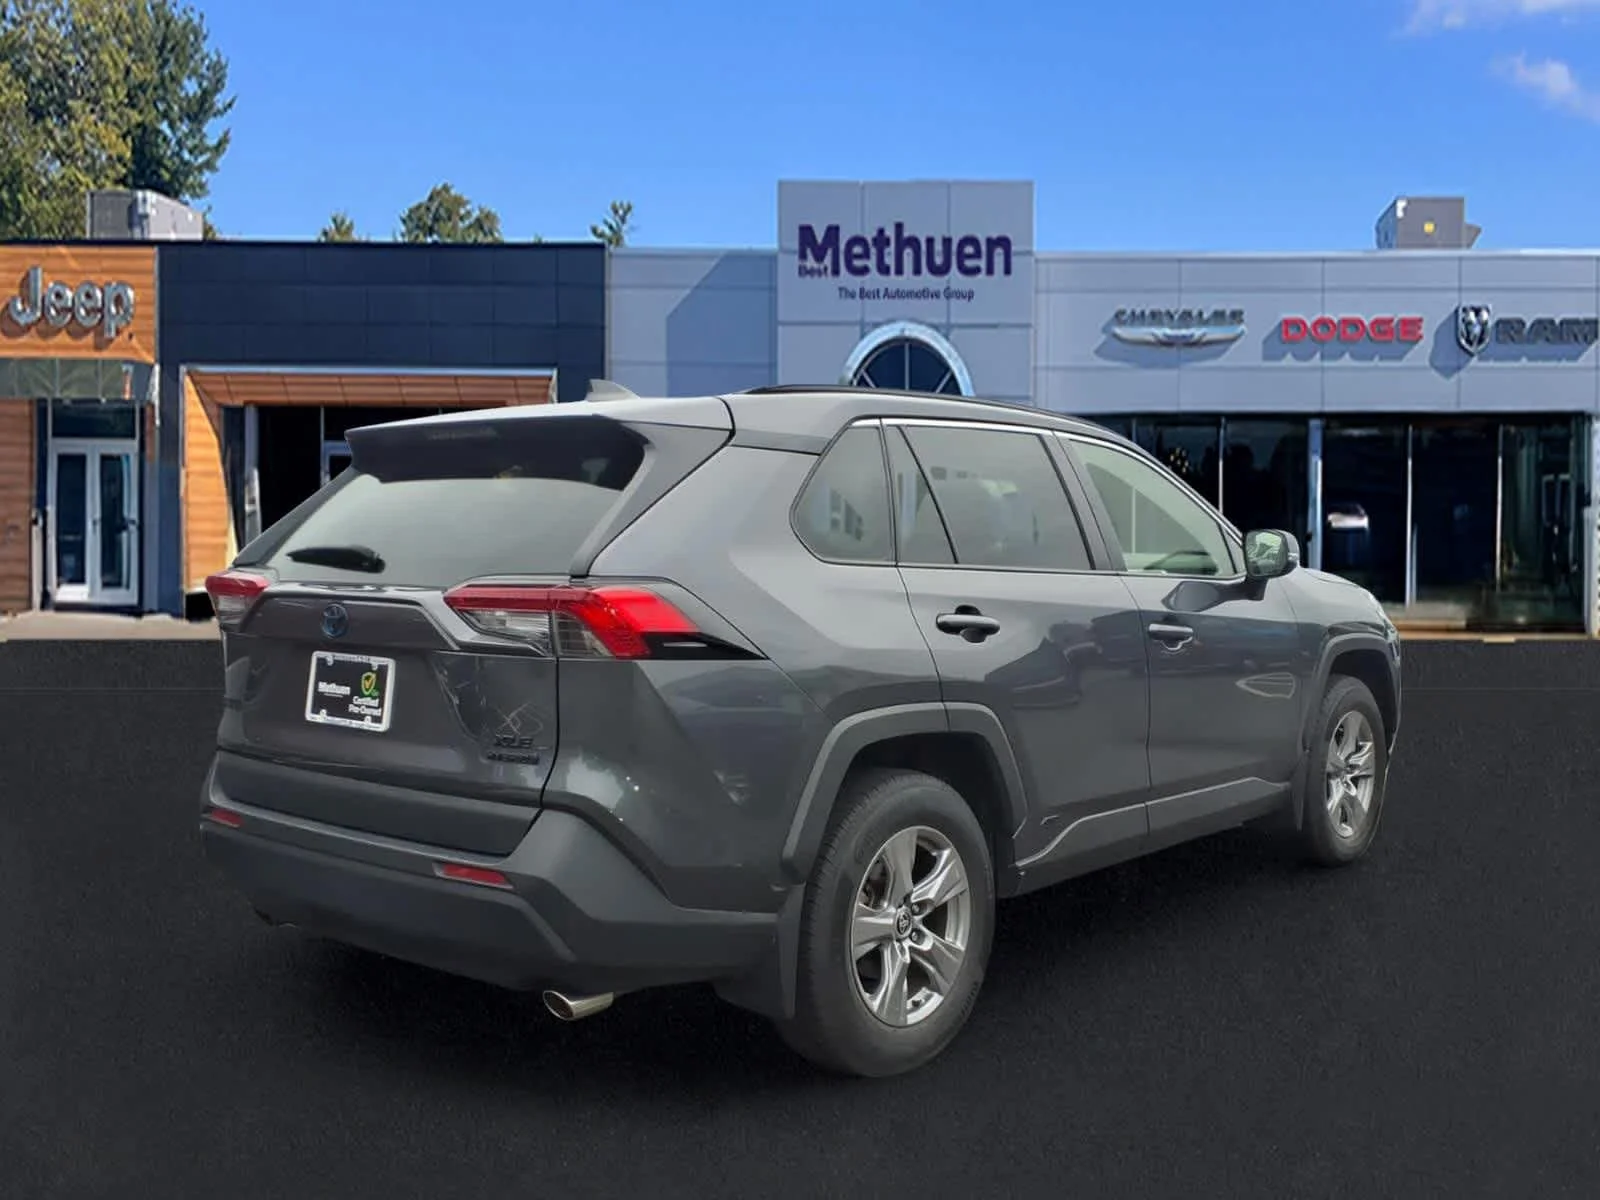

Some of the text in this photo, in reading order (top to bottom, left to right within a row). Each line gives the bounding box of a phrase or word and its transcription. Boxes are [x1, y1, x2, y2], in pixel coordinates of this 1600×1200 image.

[798, 221, 1012, 277] Methuen
[9, 266, 135, 338] Jeep
[838, 287, 974, 302] The Best Automotive Group
[1114, 308, 1244, 327] CHRYSLER
[1281, 316, 1423, 343] DODGE
[1495, 317, 1599, 344] RAM
